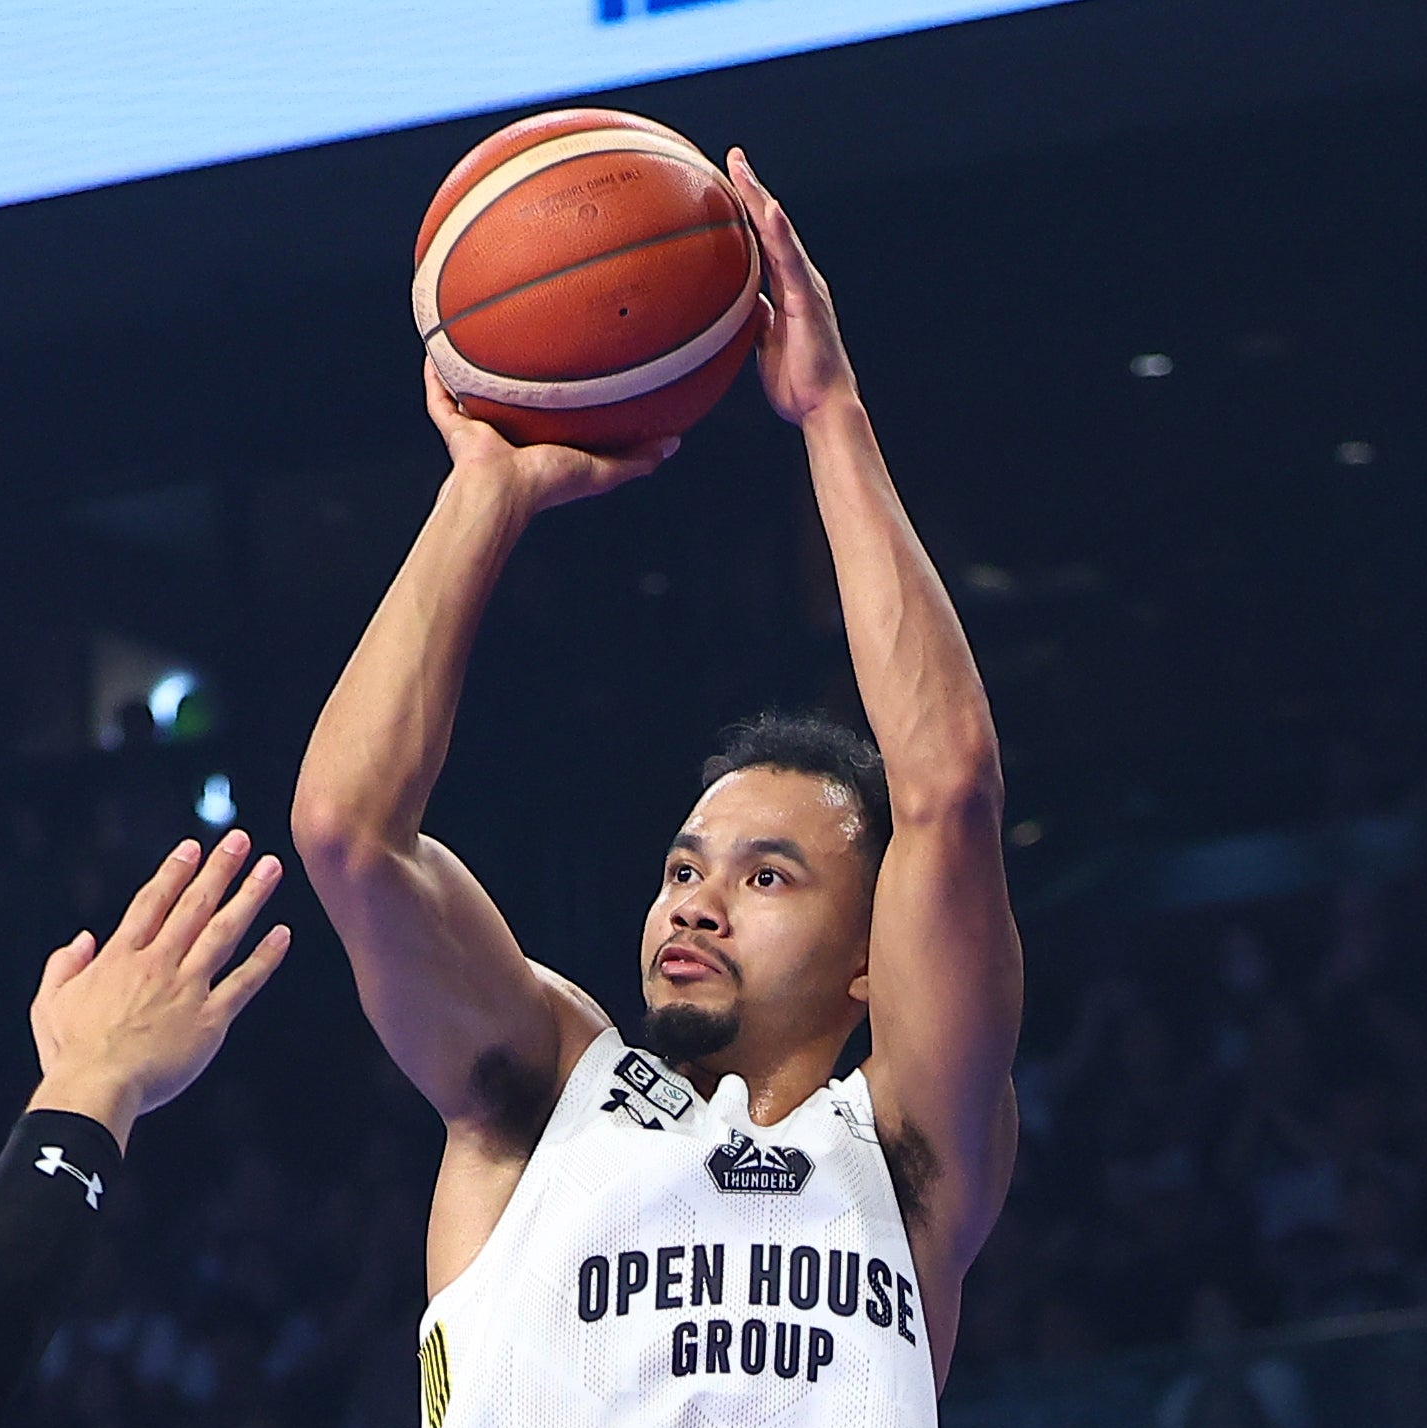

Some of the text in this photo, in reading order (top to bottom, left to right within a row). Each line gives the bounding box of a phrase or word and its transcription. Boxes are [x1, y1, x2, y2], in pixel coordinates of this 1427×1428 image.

[723, 1171, 797, 1189] THUNDERS
[578, 1244, 917, 1347] OPEN HOUSE
[672, 1319, 834, 1383] GROUP
